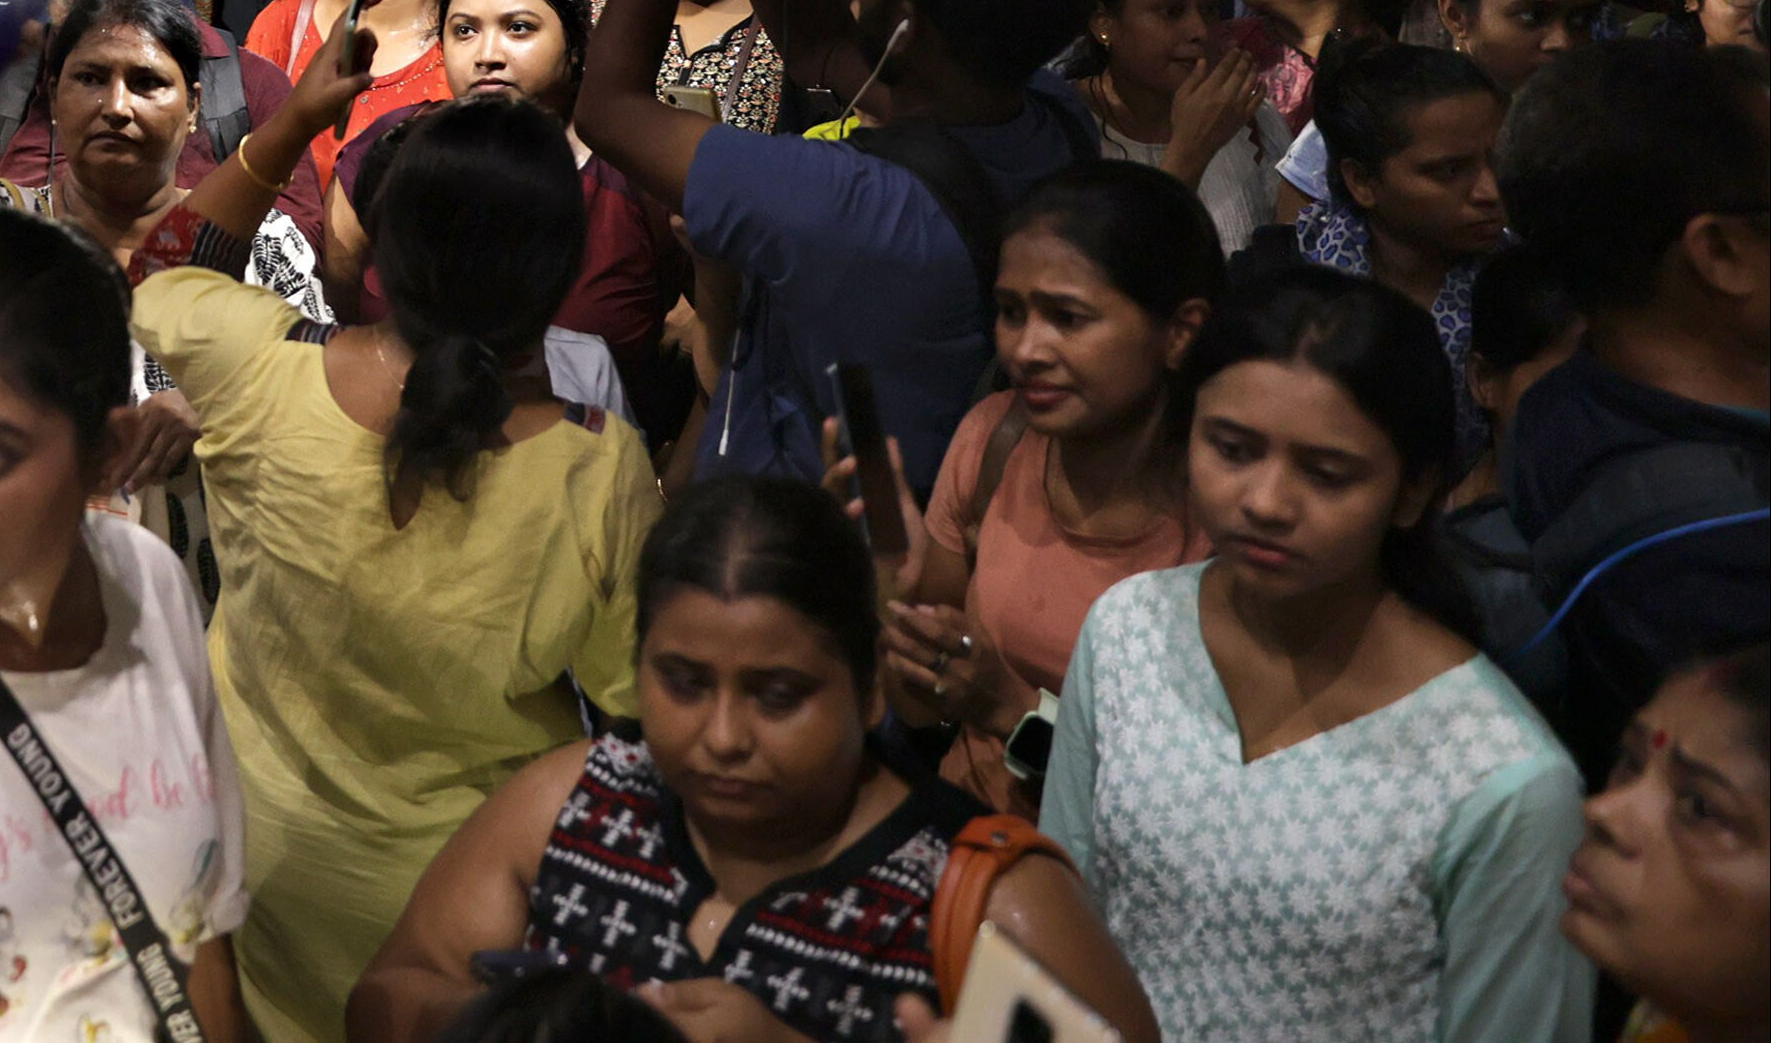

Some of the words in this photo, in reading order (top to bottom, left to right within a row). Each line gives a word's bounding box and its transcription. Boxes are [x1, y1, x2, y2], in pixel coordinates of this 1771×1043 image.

[7, 722, 73, 816] YOUNG
[65, 810, 143, 930] FOREVER
[137, 942, 184, 1012] YOUNG
